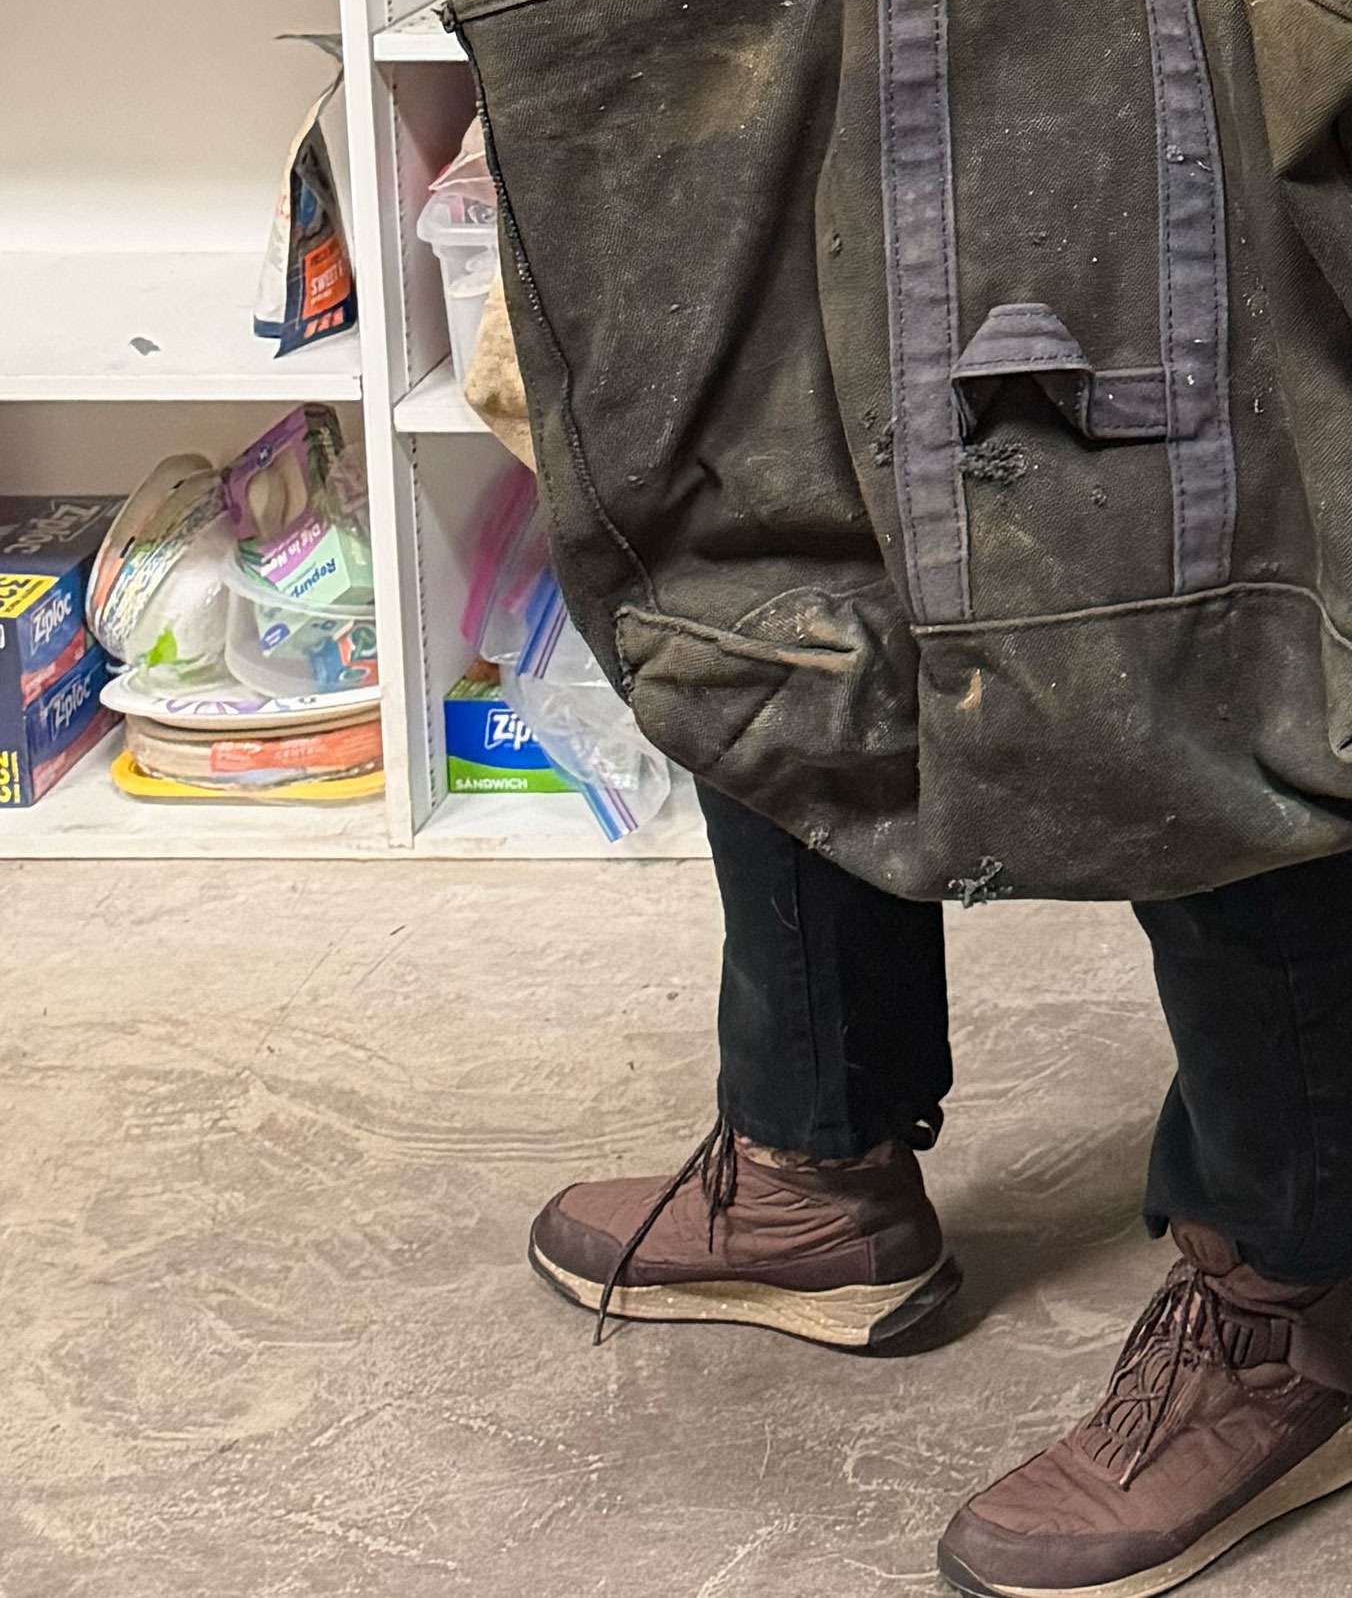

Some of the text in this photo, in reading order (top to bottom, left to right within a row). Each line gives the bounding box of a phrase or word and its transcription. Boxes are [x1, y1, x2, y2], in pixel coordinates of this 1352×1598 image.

[32, 590, 73, 647] Ziploc
[53, 674, 92, 730] Ziploc
[455, 777, 528, 790] SANDWICH
